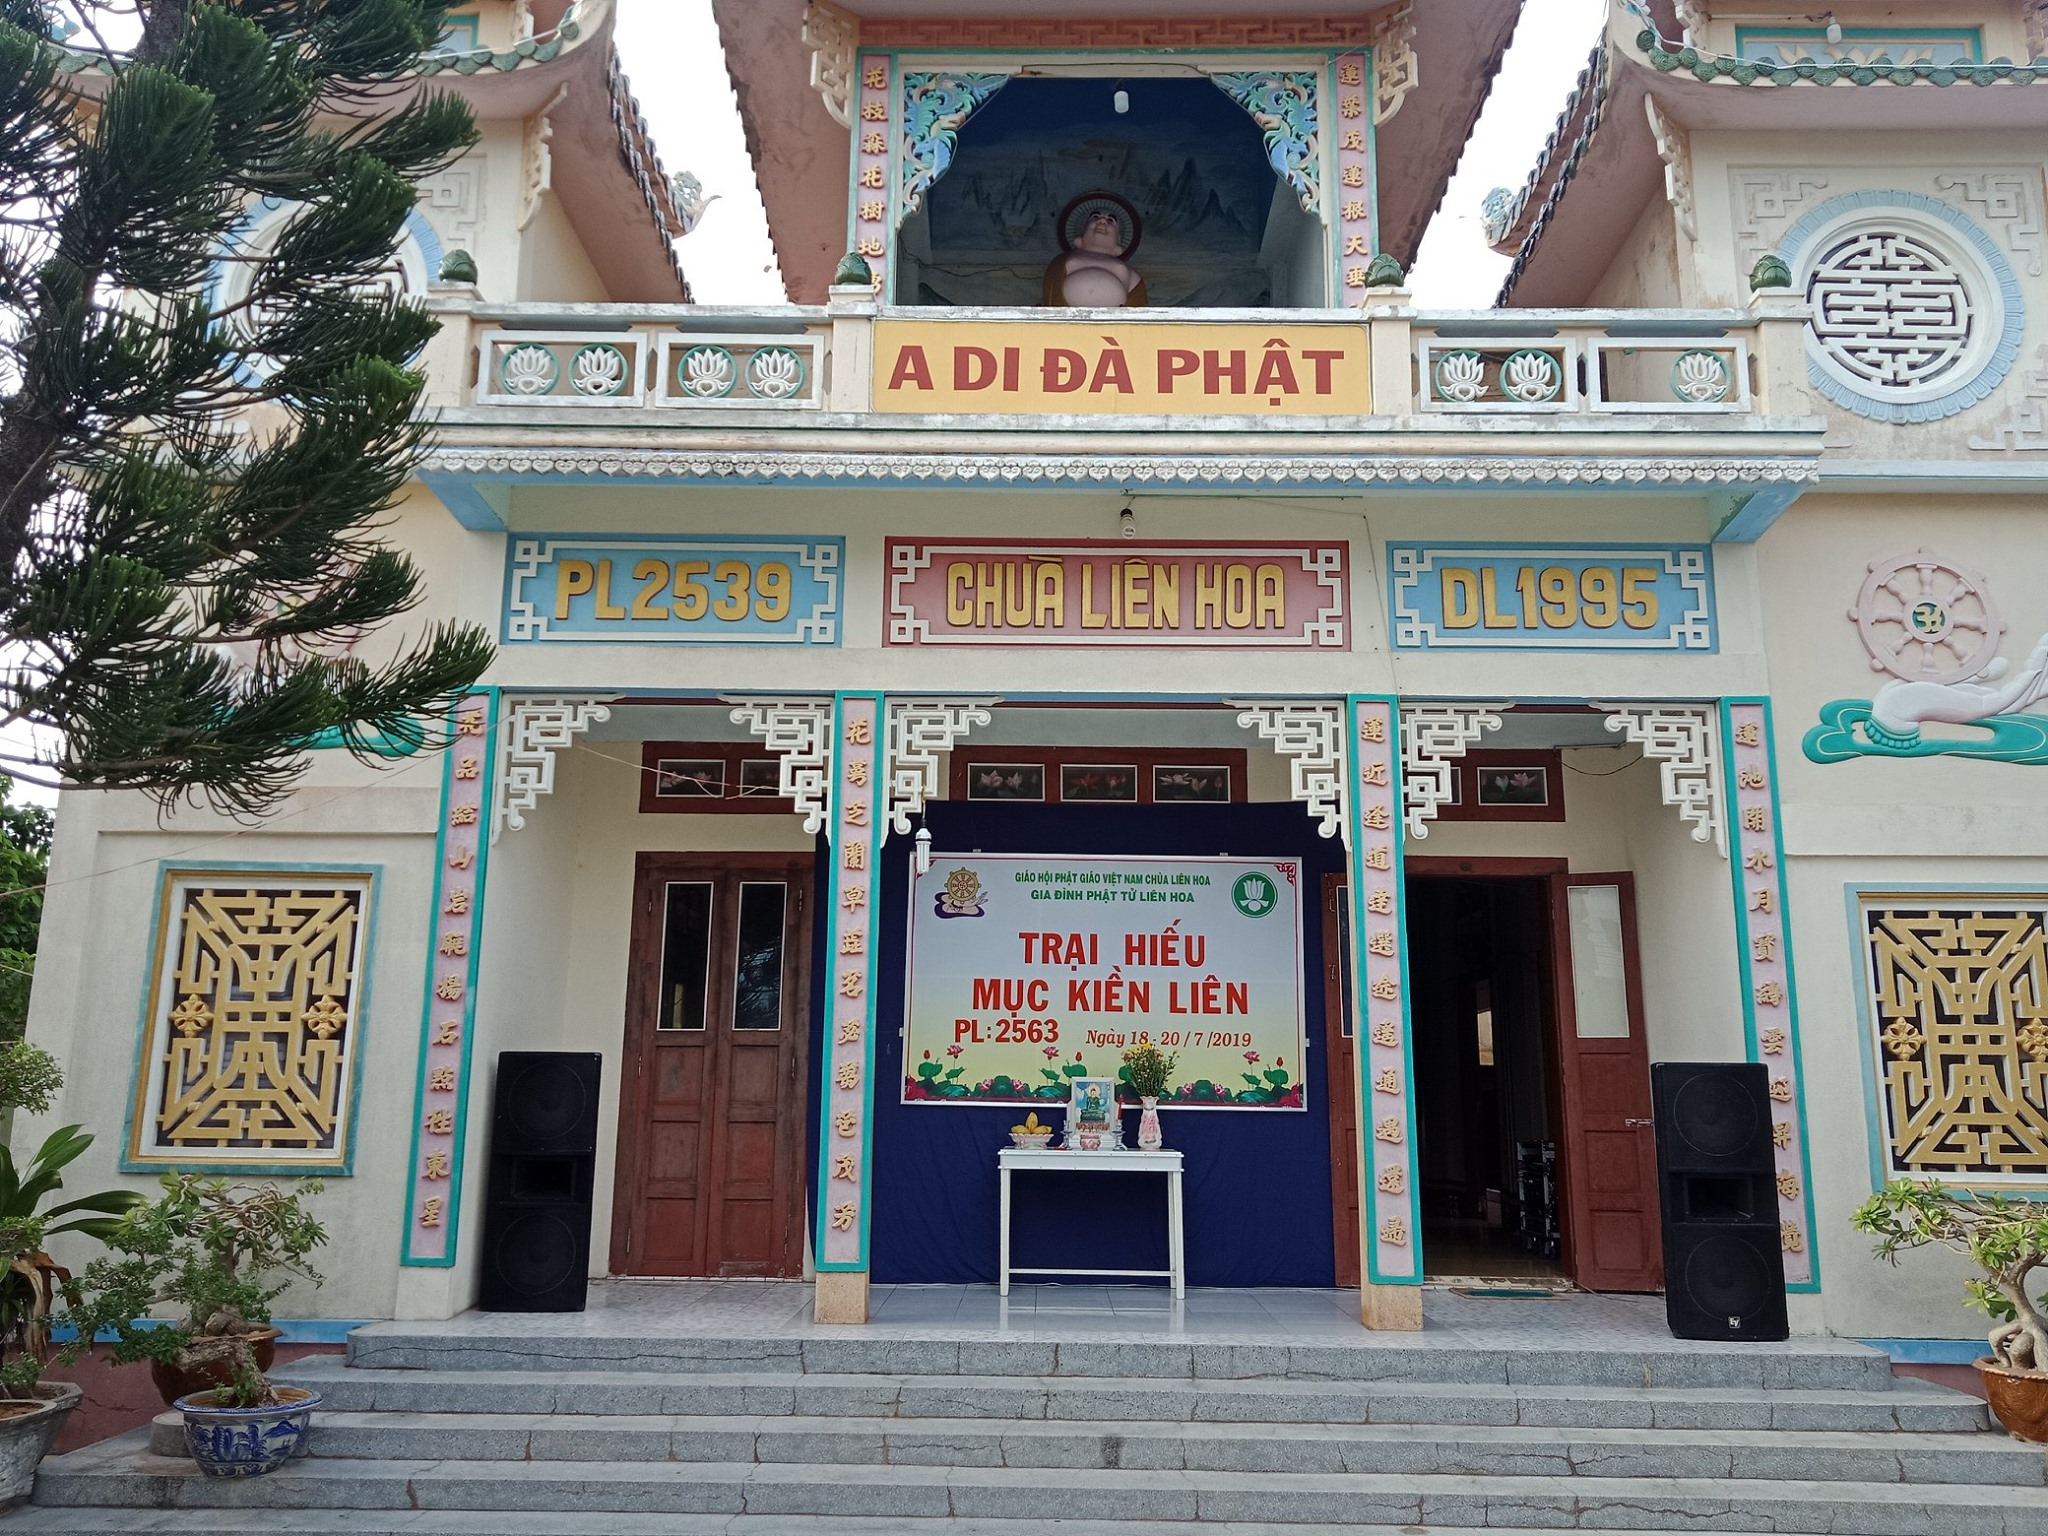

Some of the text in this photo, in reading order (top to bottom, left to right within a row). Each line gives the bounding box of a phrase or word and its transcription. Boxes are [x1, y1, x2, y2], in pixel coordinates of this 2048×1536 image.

[889, 336, 1344, 406] A DI ĐÀ PHẬT
[555, 559, 792, 622] PL2539
[1081, 559, 1179, 629] LIÊN
[1195, 563, 1286, 629] HOA
[1442, 567, 1658, 629] DL1995
[1015, 870, 1211, 886] GIÁO HỘI PHẬT GIÁO VIỆT NAM CHÙA LIÊN HOA
[1031, 888, 1195, 903] GIA ĐÌNH PHẬT TỬ LIÊN HOA
[1019, 919, 1206, 971] TRẠI HIẾU
[973, 965, 1249, 1018] MỤC KIỀN LIÊN
[954, 1019, 1059, 1043] PL:2563
[1086, 1028, 1125, 1048] Ngày
